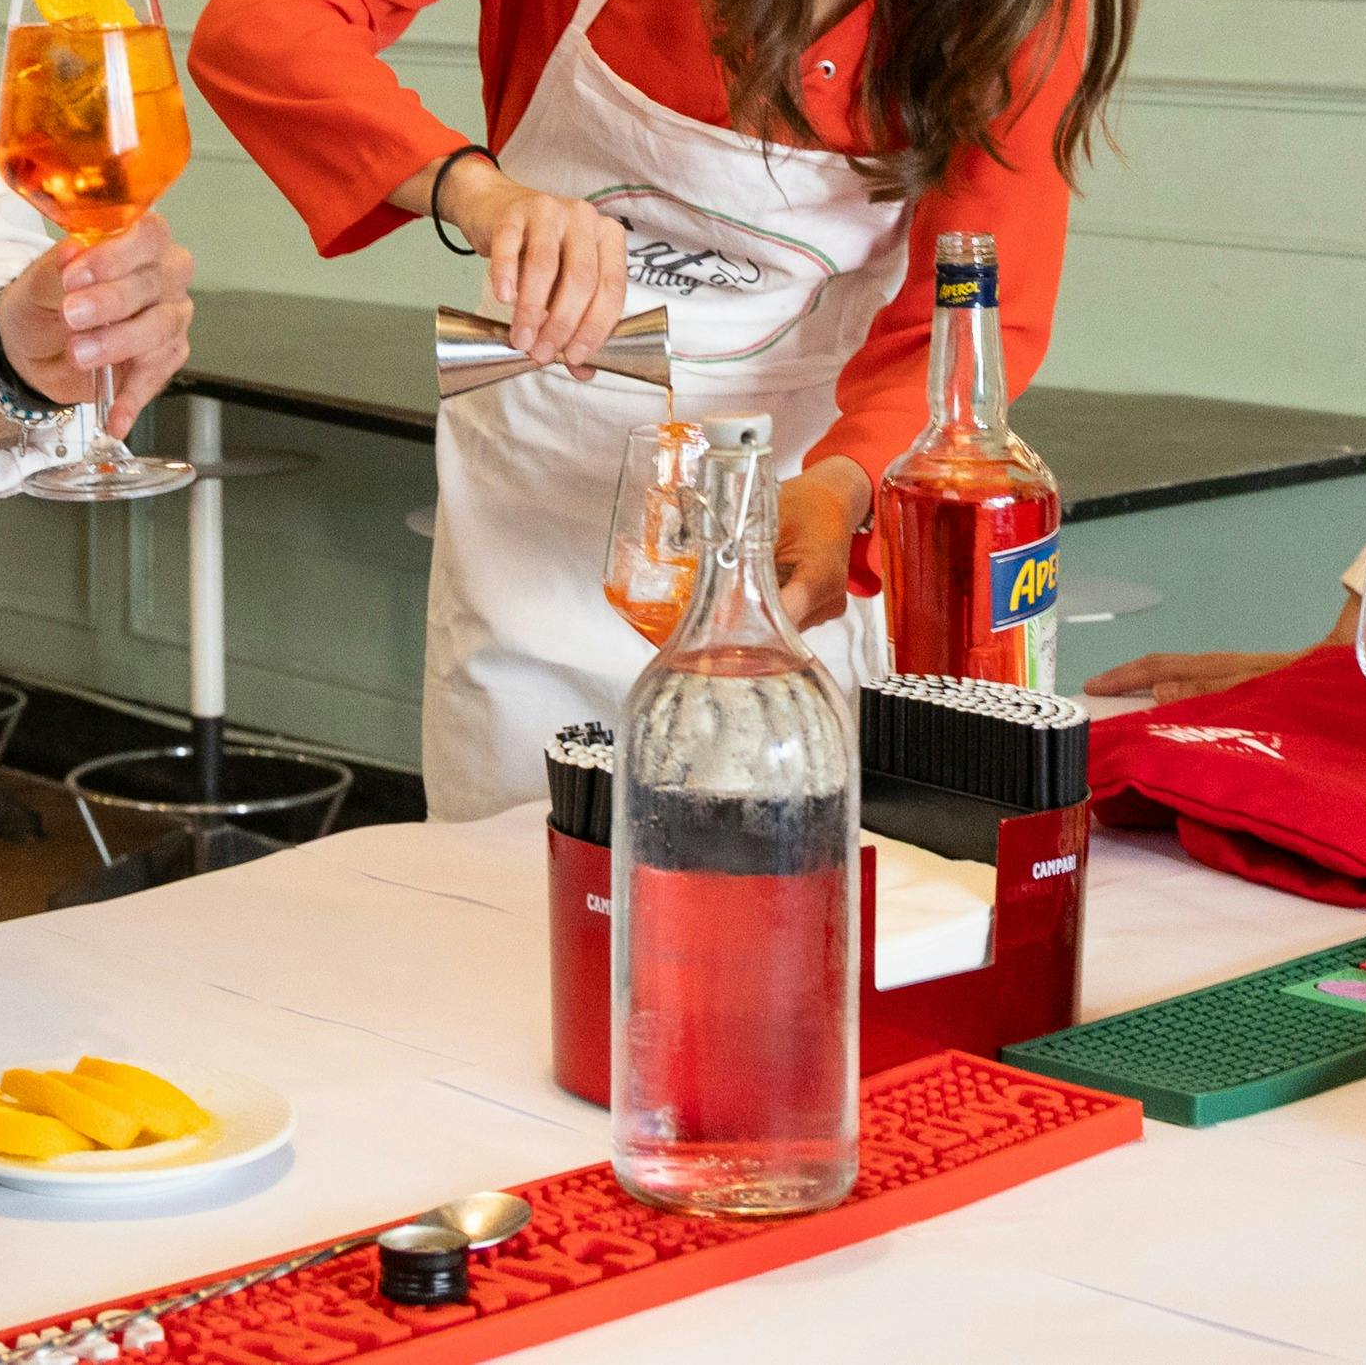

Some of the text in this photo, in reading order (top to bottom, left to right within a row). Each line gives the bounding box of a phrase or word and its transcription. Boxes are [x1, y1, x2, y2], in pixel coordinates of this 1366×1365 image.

[628, 241, 716, 271] at
[1009, 549, 1059, 612] APE
[1032, 853, 1077, 880] CAMPARI
